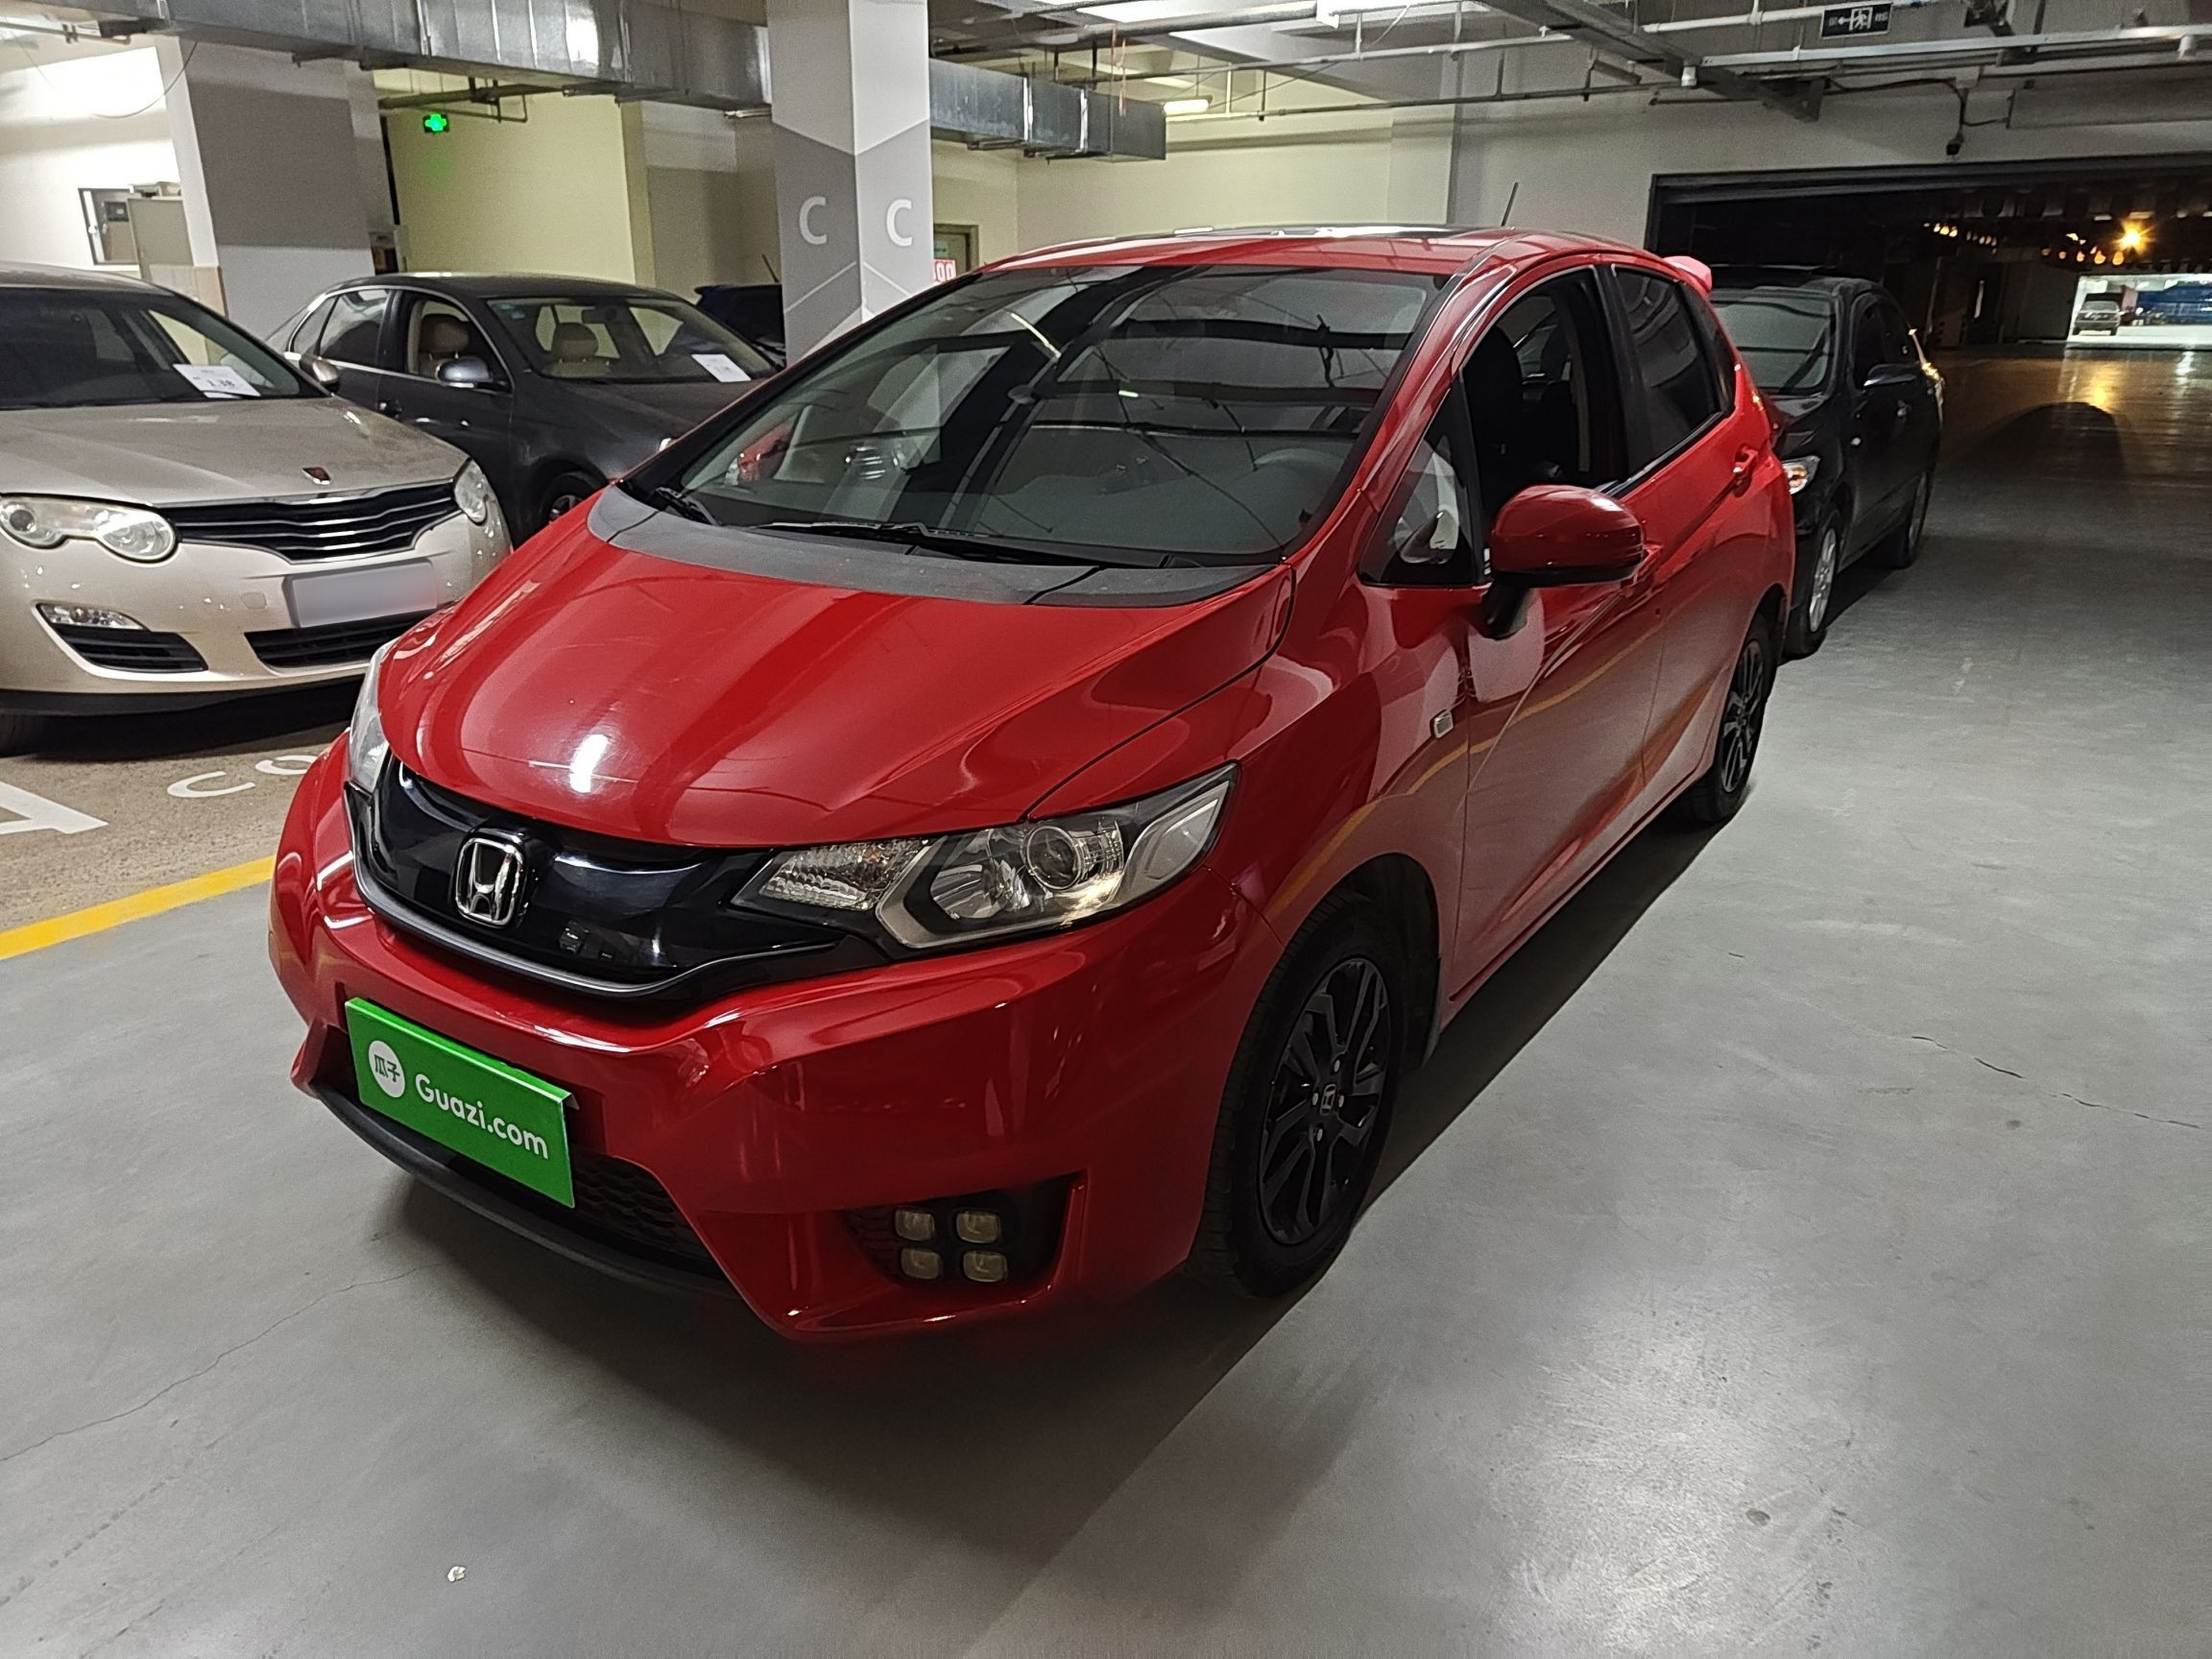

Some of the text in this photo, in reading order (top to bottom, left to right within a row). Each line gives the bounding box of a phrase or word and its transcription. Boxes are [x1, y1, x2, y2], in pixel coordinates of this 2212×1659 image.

[800, 196, 827, 244] C
[887, 199, 912, 247] C
[934, 262, 955, 282] 00
[374, 1054, 401, 1082] 瓜子
[415, 1073, 549, 1160] Guazi.com
